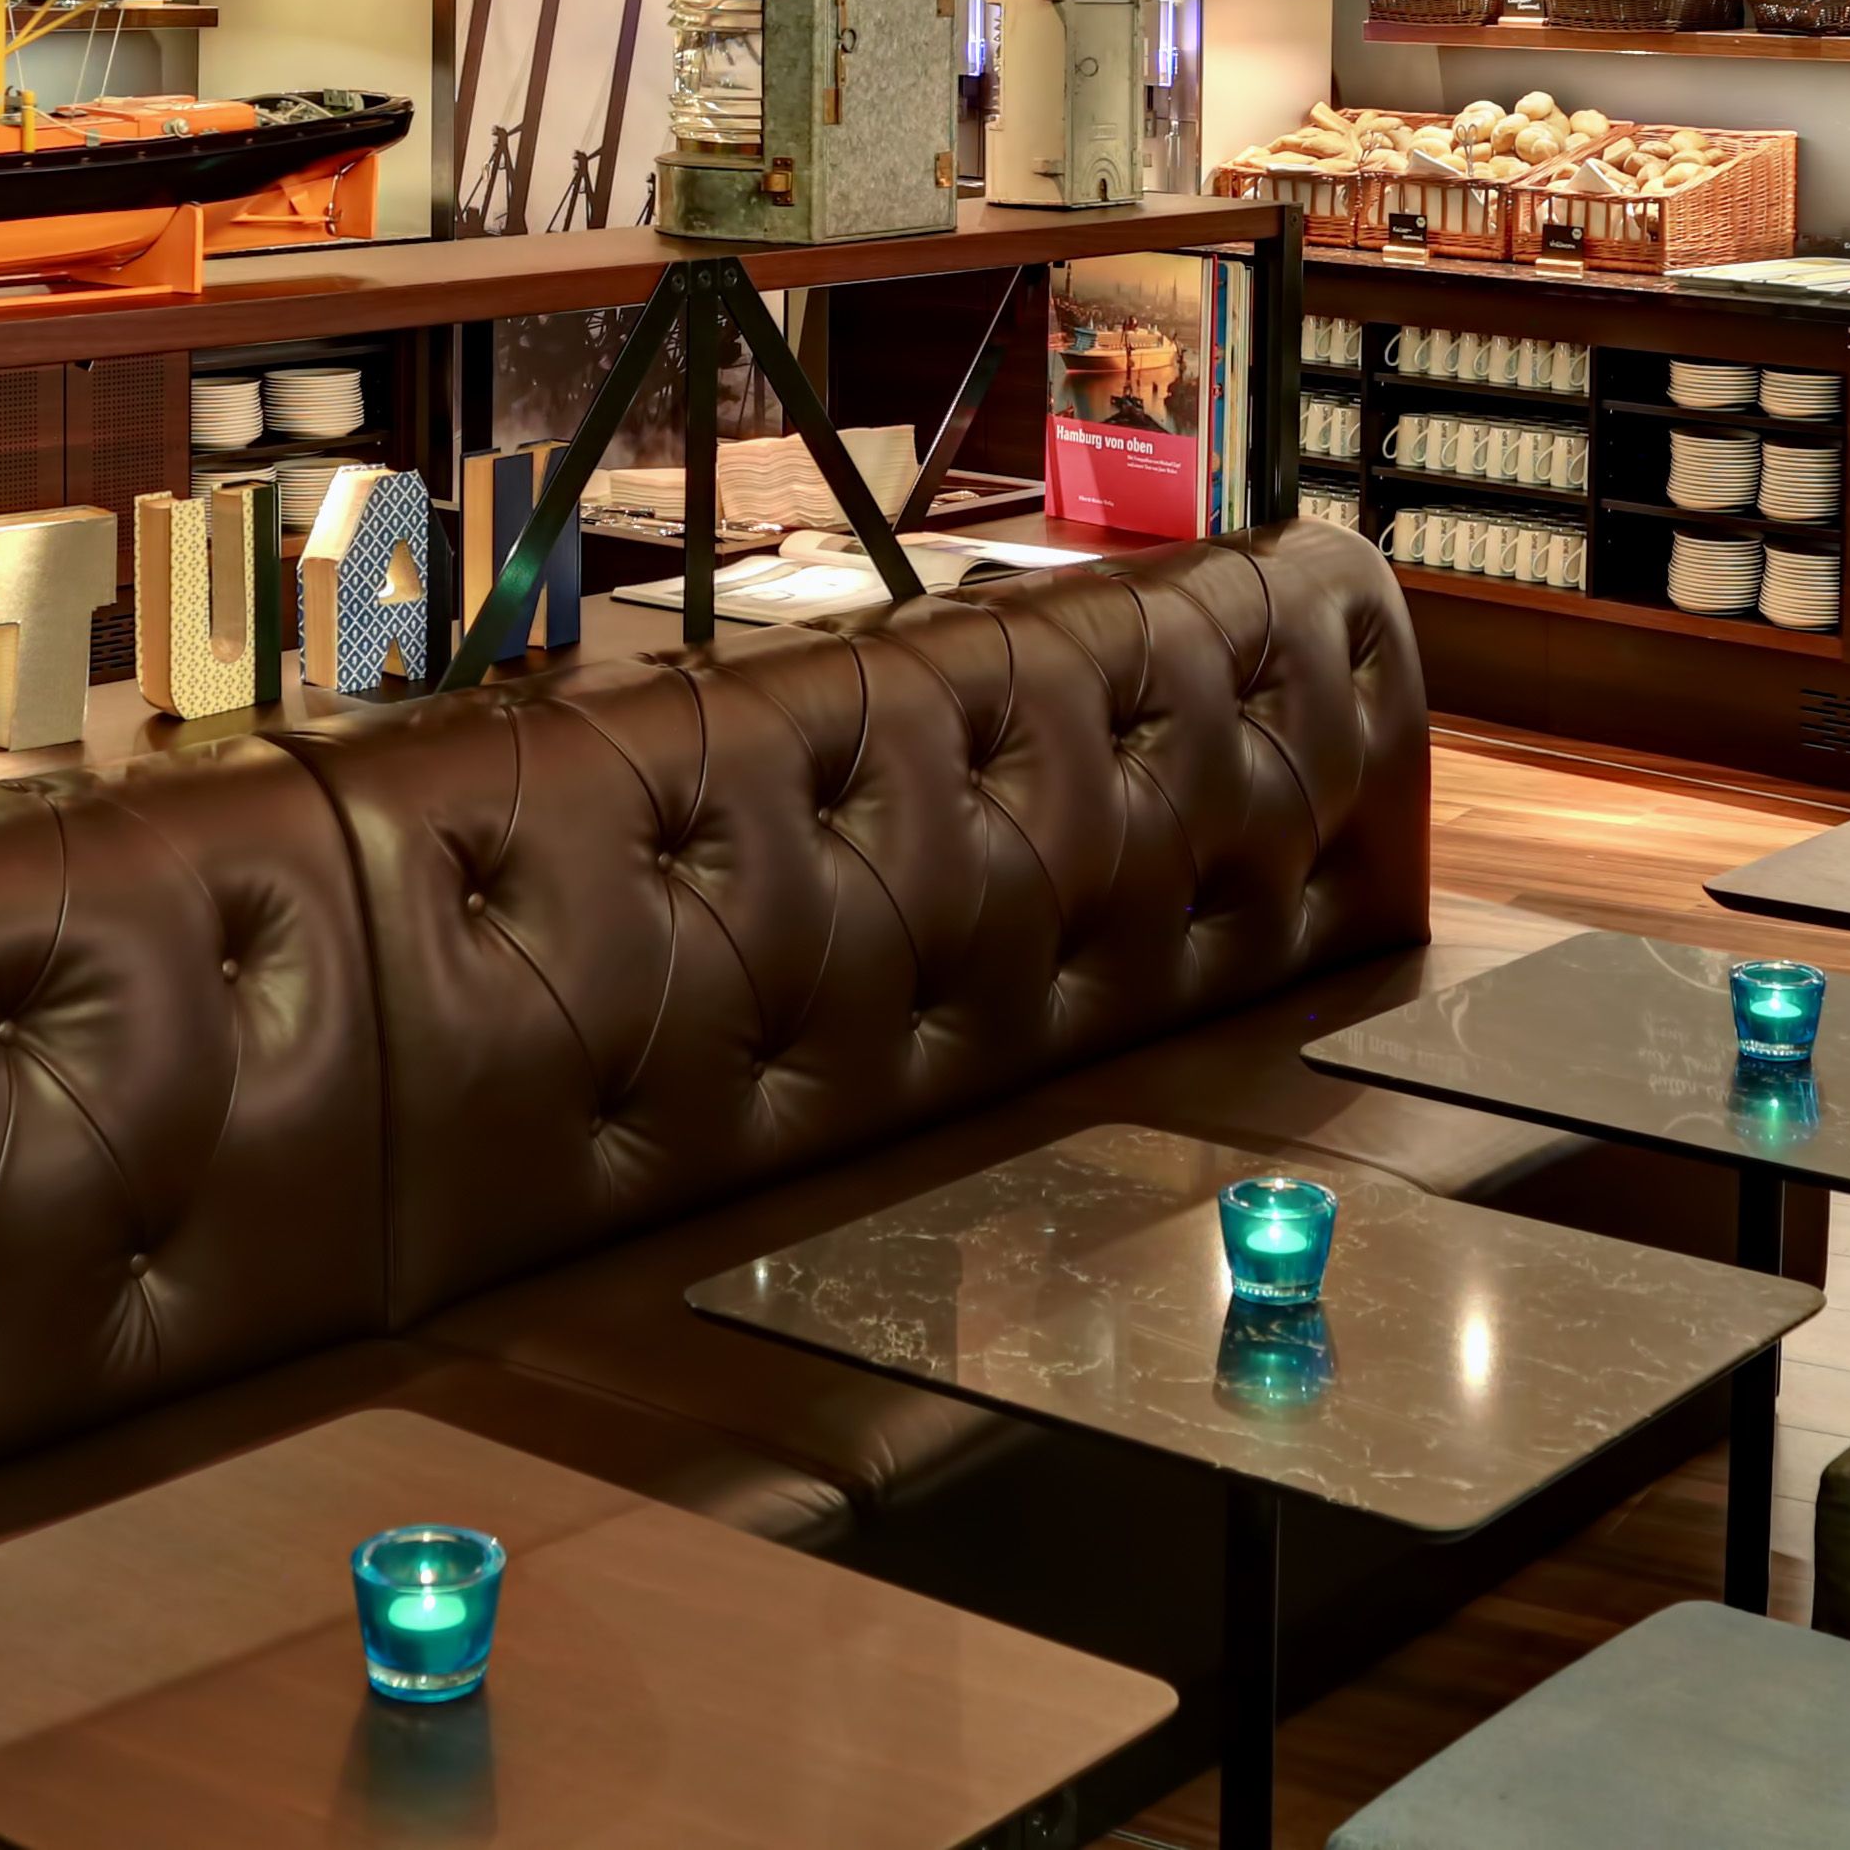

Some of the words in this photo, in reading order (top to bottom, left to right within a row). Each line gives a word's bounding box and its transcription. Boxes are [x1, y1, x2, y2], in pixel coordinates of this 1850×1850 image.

[1056, 424, 1102, 449] Hamburg
[1104, 436, 1124, 449] von
[1127, 437, 1153, 454] oben
